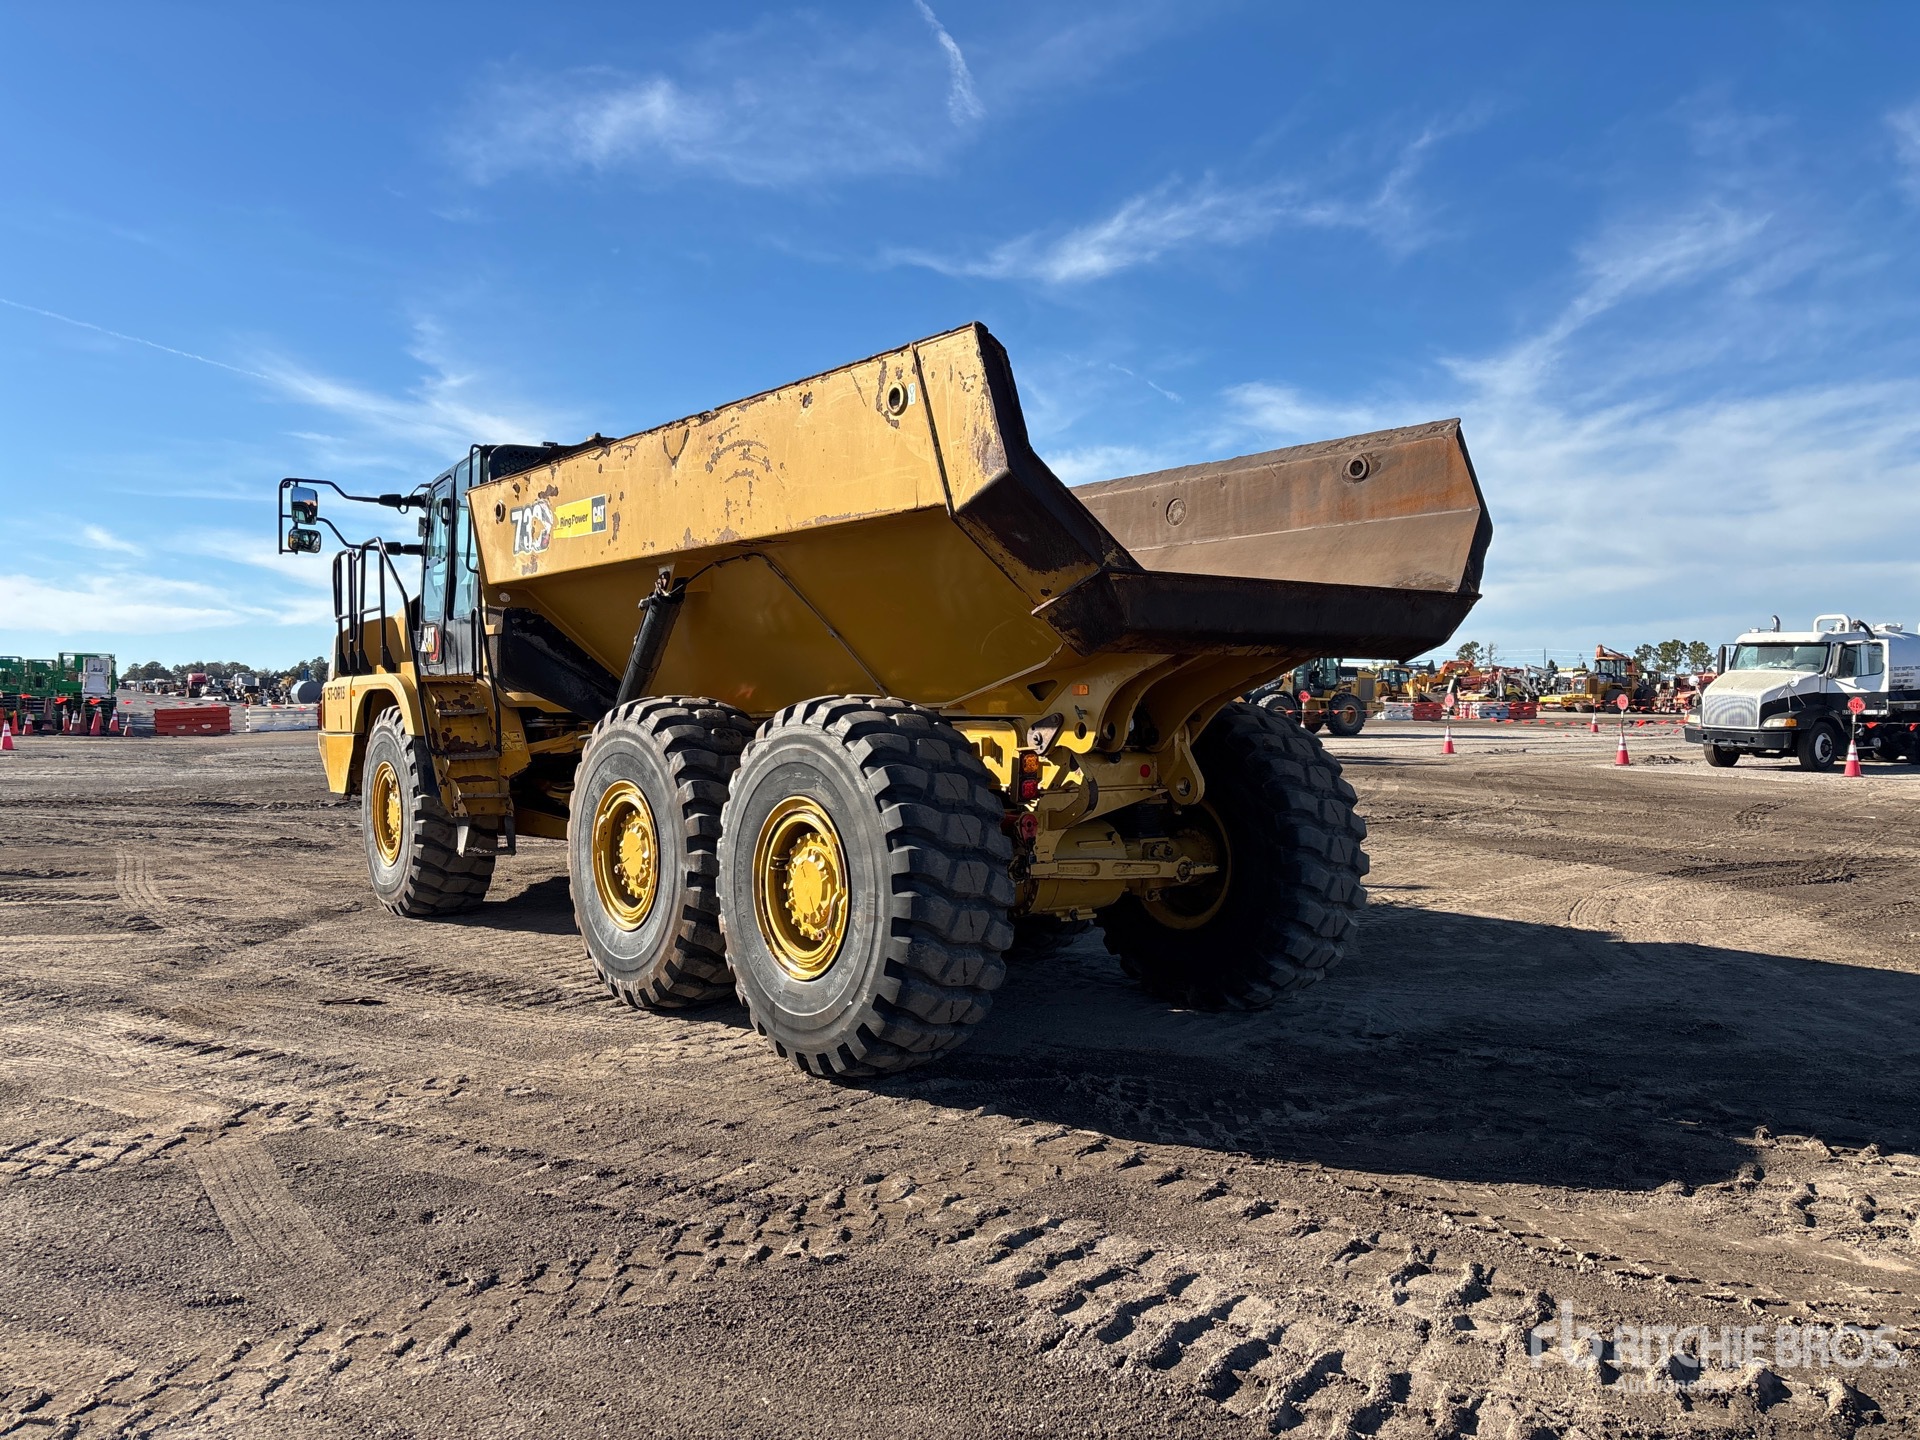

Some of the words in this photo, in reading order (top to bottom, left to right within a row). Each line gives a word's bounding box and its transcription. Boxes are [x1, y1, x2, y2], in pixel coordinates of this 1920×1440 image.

[560, 516, 572, 528] Ring
[572, 513, 588, 525] Power
[593, 505, 605, 523] CAT
[423, 626, 435, 652] CAT
